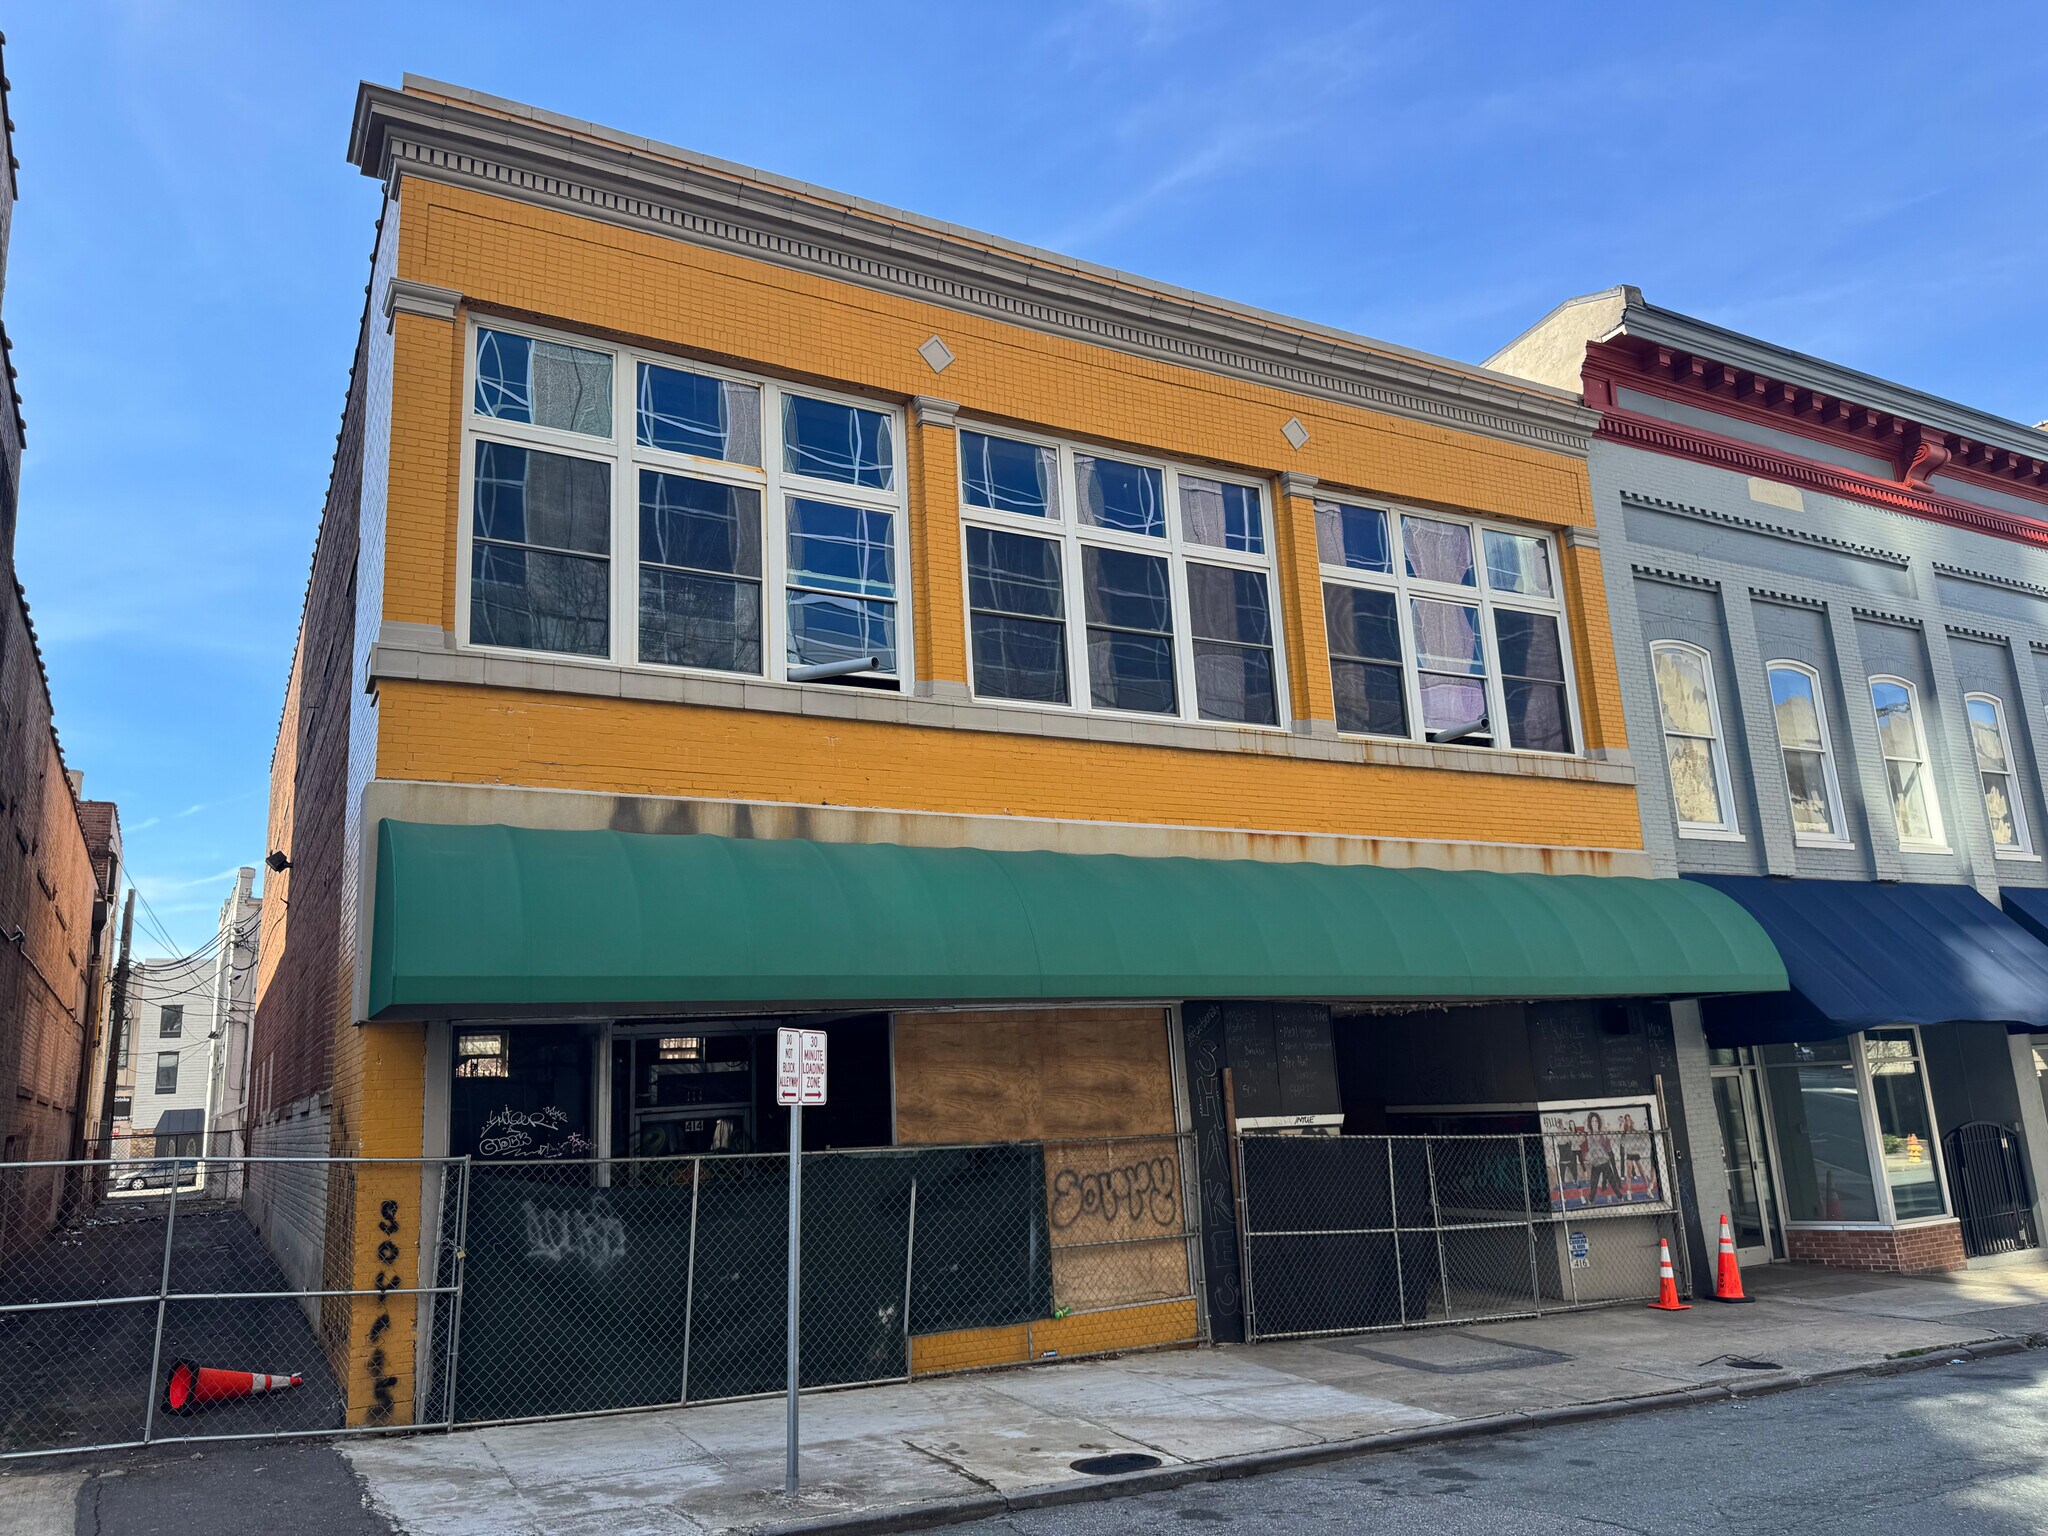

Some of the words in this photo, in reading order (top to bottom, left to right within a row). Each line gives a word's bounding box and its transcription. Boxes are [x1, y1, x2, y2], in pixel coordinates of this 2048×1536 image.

[786, 1034, 793, 1045] DO
[810, 1036, 818, 1048] 30
[785, 1048, 793, 1059] NOT
[804, 1050, 824, 1061] MINUTE
[782, 1062, 796, 1073] BLOCK
[802, 1062, 825, 1075] LOADING
[779, 1076, 799, 1088] ALLEYWAY
[806, 1076, 821, 1089] ZONE
[685, 1121, 703, 1131] 414
